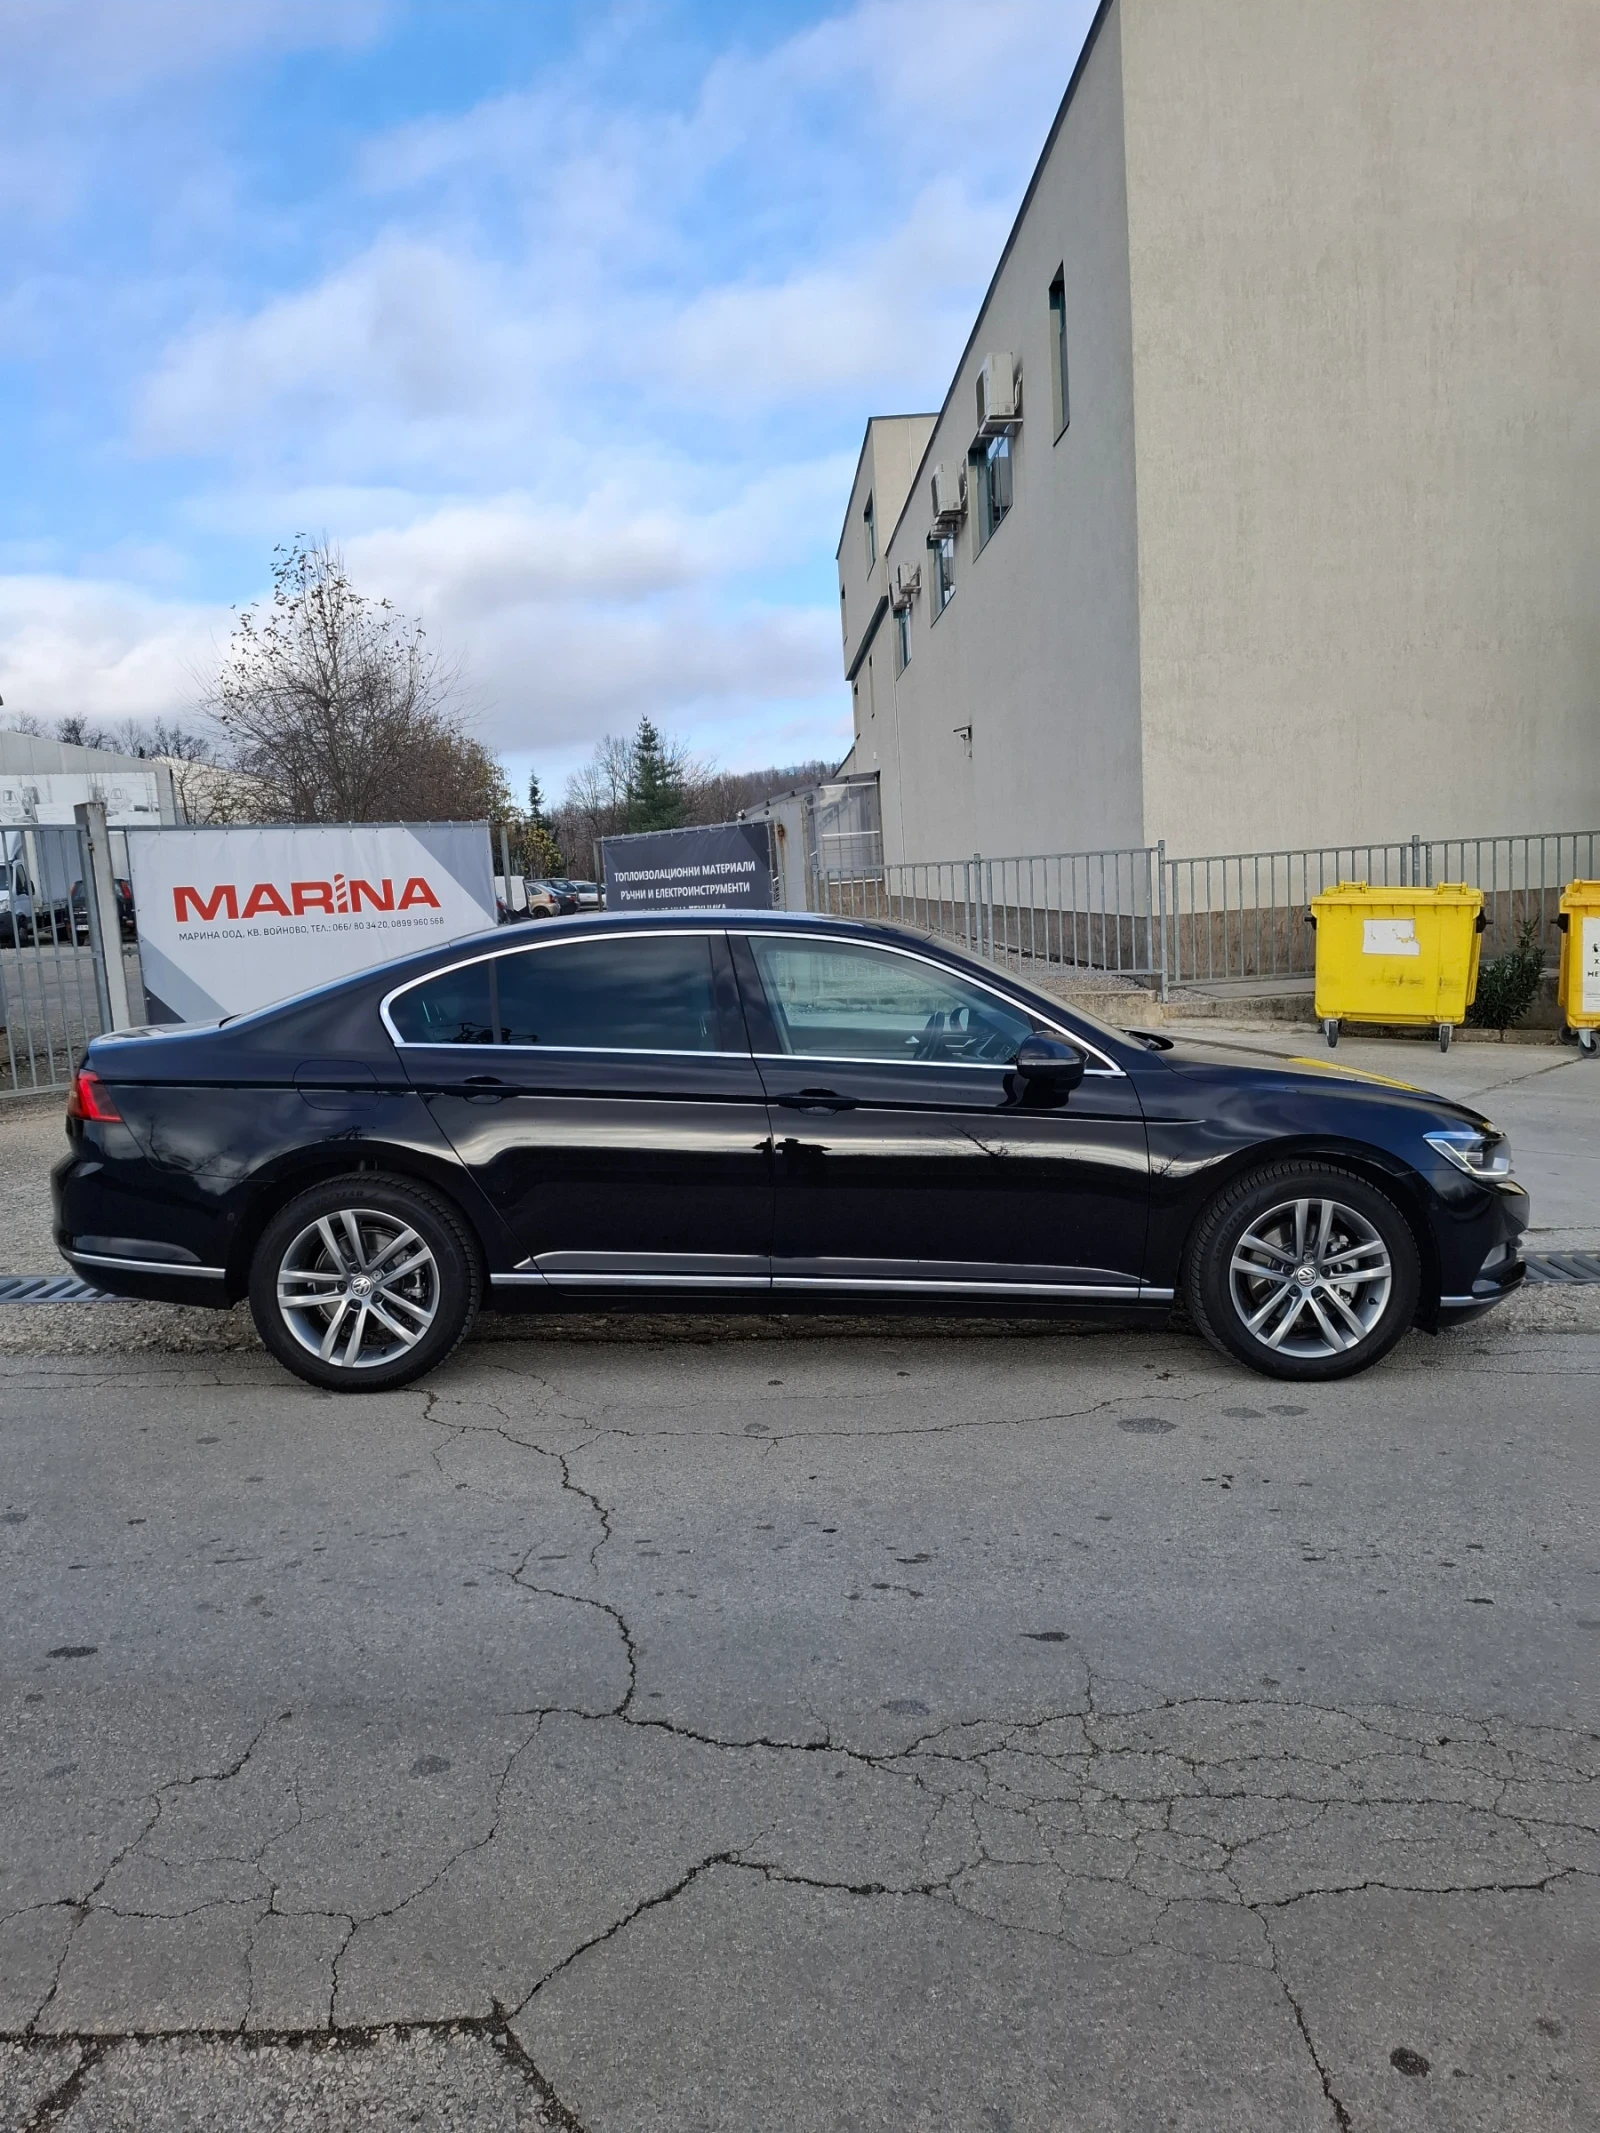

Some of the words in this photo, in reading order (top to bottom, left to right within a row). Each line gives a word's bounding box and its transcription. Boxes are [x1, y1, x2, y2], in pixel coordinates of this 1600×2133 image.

[614, 866, 700, 882] ТОПЛОИЗОЛАЦИОННИ
[702, 861, 756, 876] МАТЕРИАЛИ
[173, 873, 442, 922] MARINA
[620, 890, 646, 900] РЪЧНИ
[648, 889, 654, 899] И
[656, 882, 750, 898] ЕЛЕКТРОИНСТРУМЕНТИ
[179, 931, 220, 941] МАРИНА
[247, 928, 262, 937] КВ.
[264, 925, 309, 936] ВОЙНОВО,
[332, 922, 352, 932] 066/
[354, 922, 364, 930] 80
[366, 921, 376, 930] 34
[391, 919, 412, 928] 0899
[414, 918, 428, 926] 960
[430, 916, 444, 925] 568
